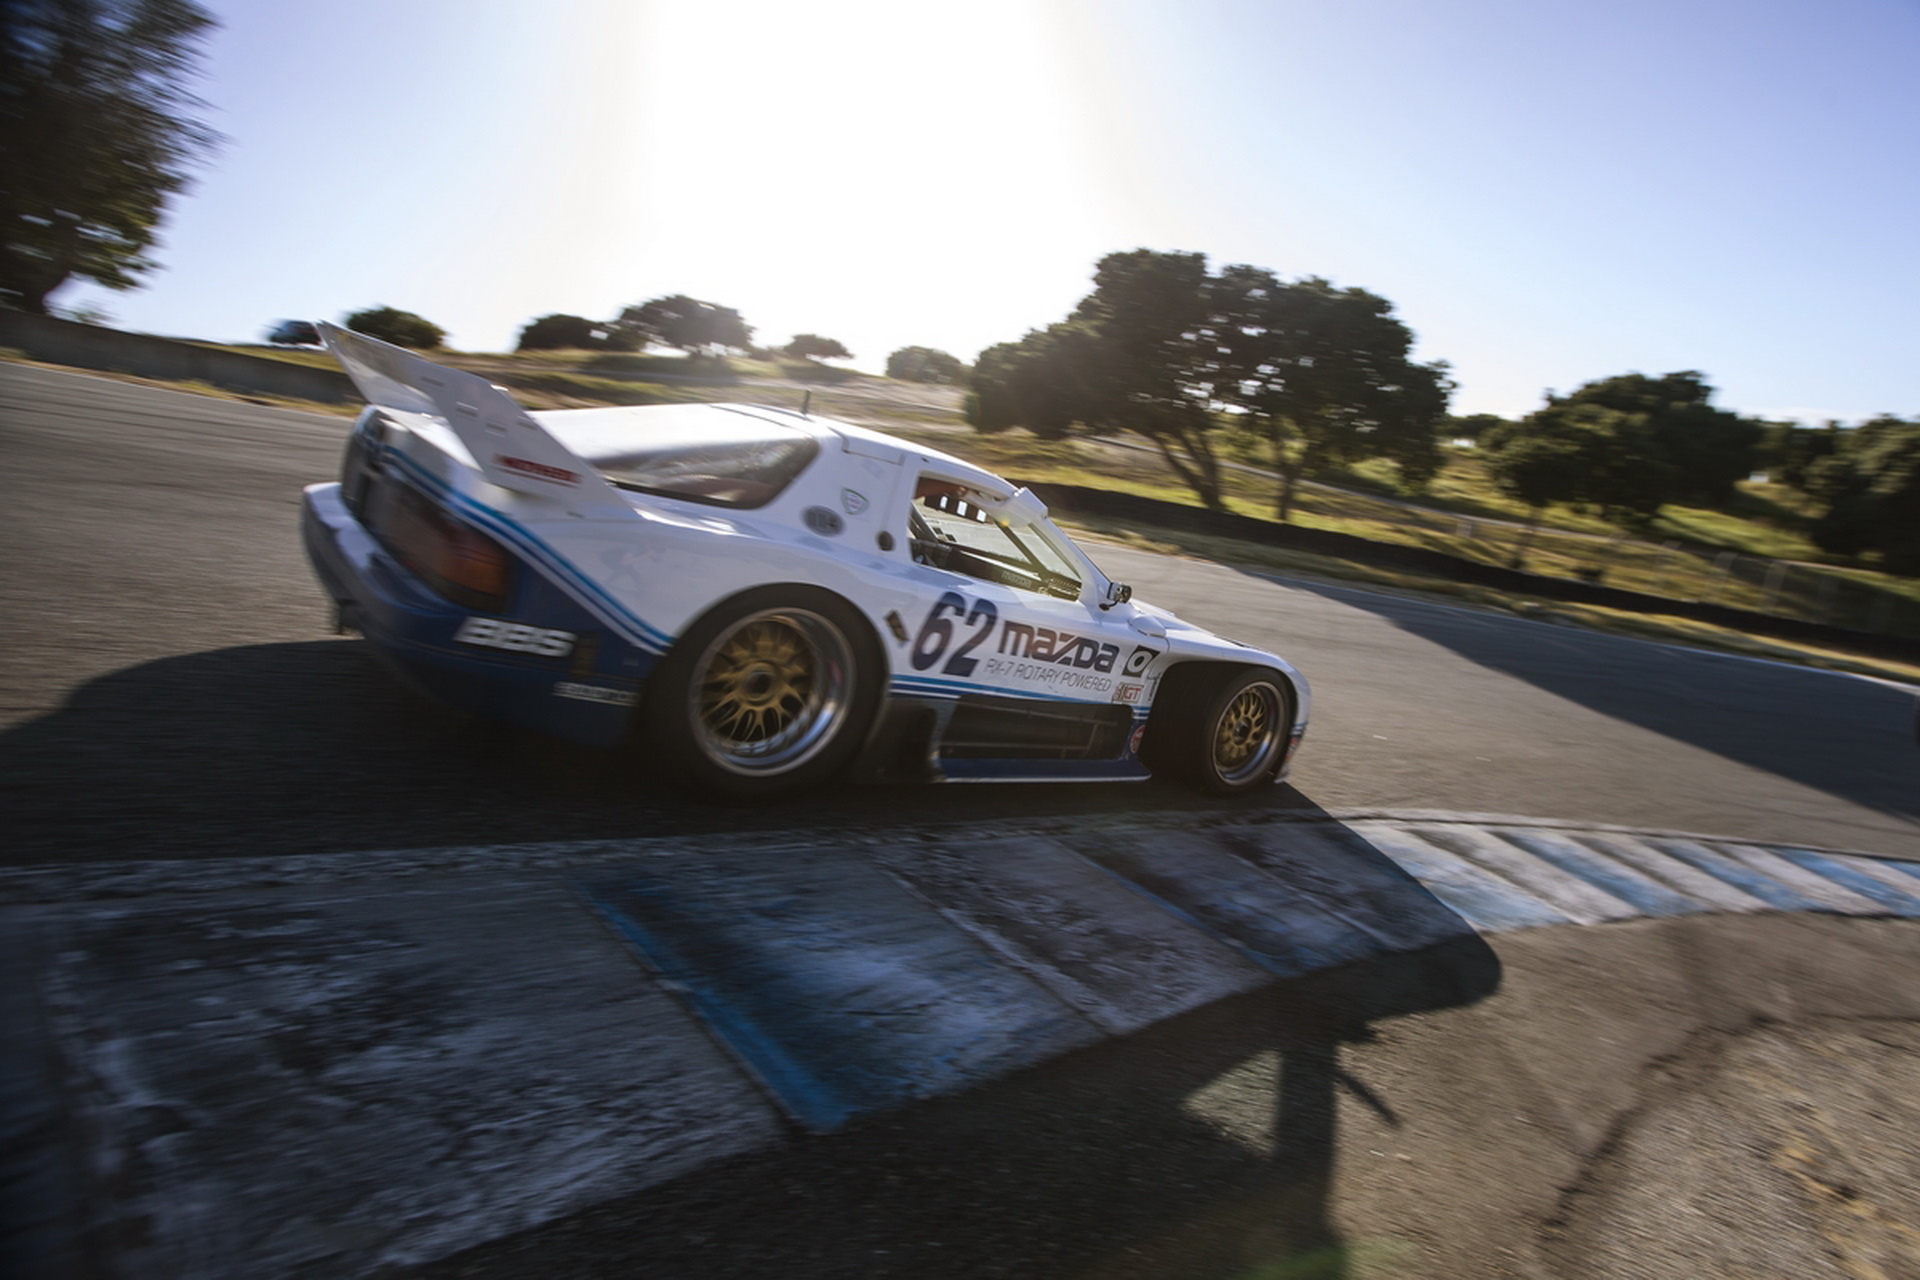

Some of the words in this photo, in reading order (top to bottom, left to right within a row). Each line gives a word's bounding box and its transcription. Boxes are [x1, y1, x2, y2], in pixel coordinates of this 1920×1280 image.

[453, 616, 577, 657] BBS
[911, 591, 998, 677] 62
[998, 621, 1119, 674] mazda
[983, 658, 1014, 677] RX-7
[1013, 663, 1060, 686] ROTARY
[1060, 671, 1112, 693] POWERED
